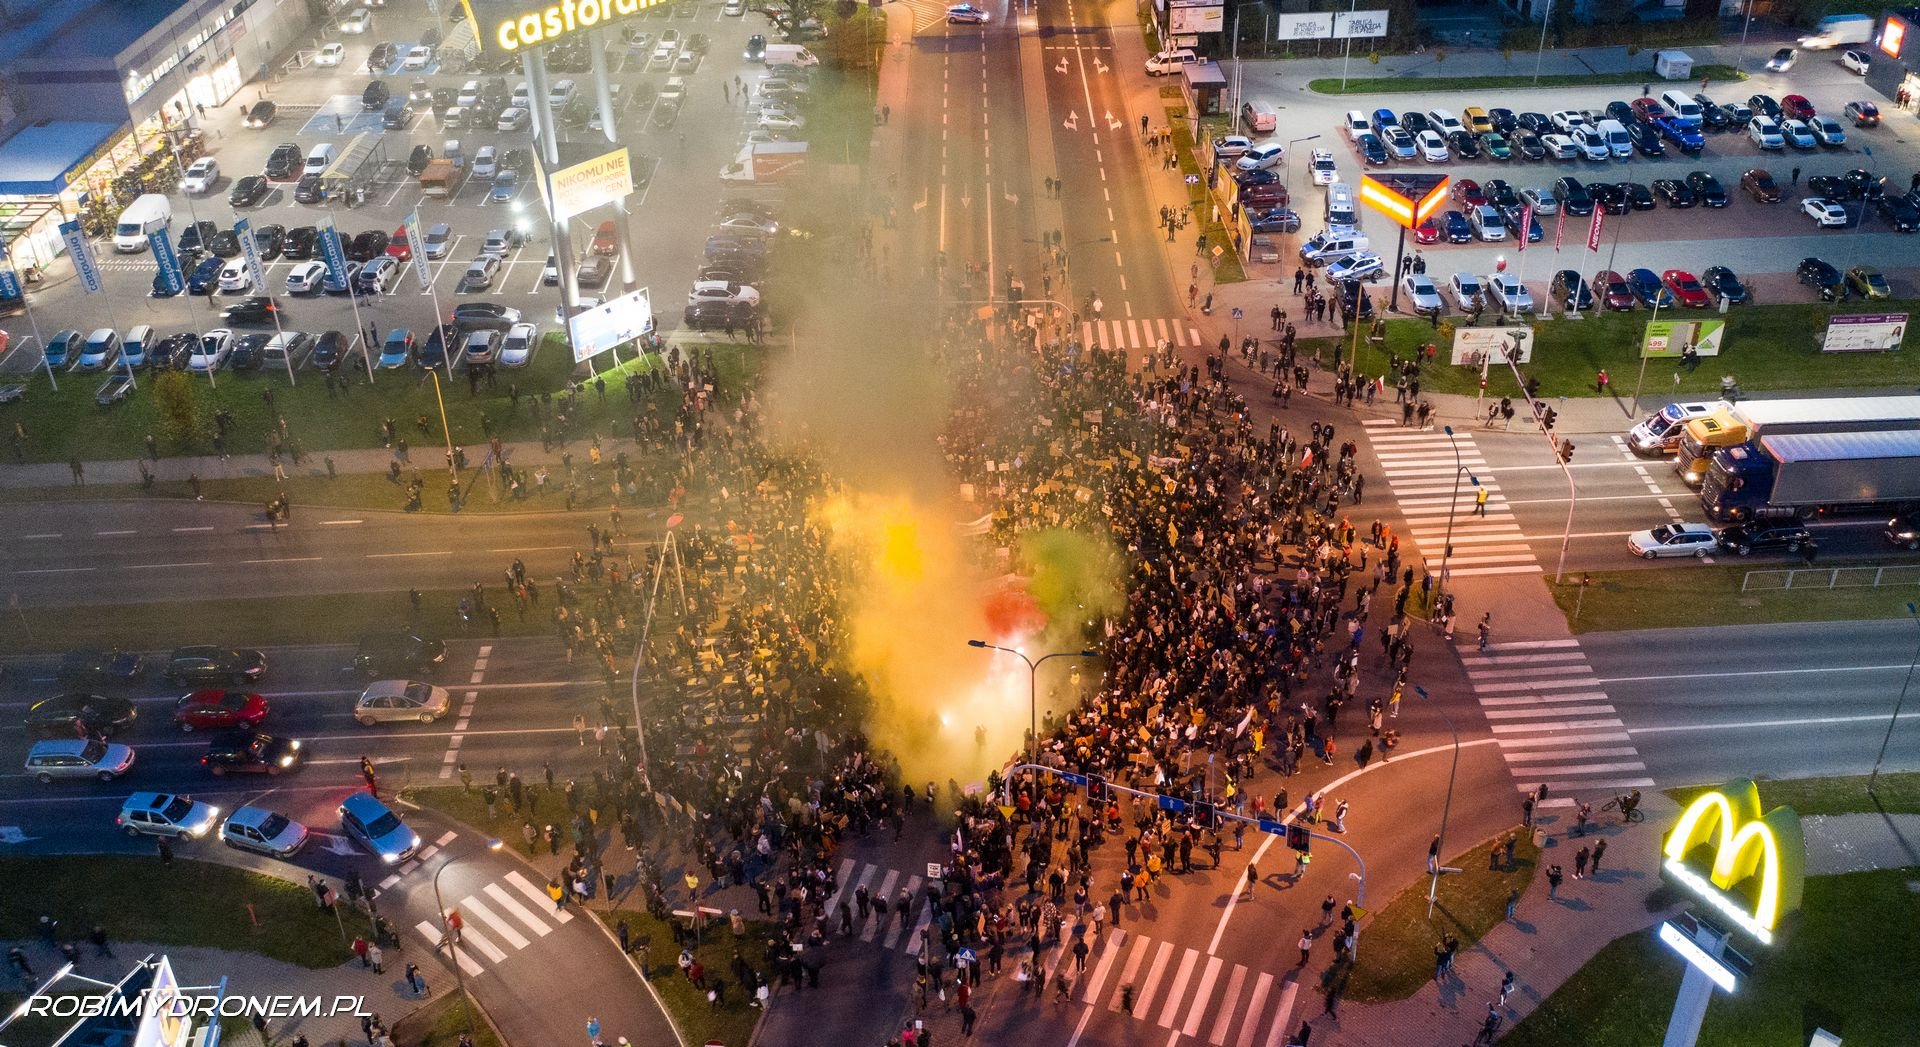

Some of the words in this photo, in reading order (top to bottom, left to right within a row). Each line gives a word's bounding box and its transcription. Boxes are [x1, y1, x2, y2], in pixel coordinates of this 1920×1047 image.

[557, 164, 604, 189] NIKOMU
[606, 156, 625, 172] NIE
[1591, 207, 1604, 249] NEONET
